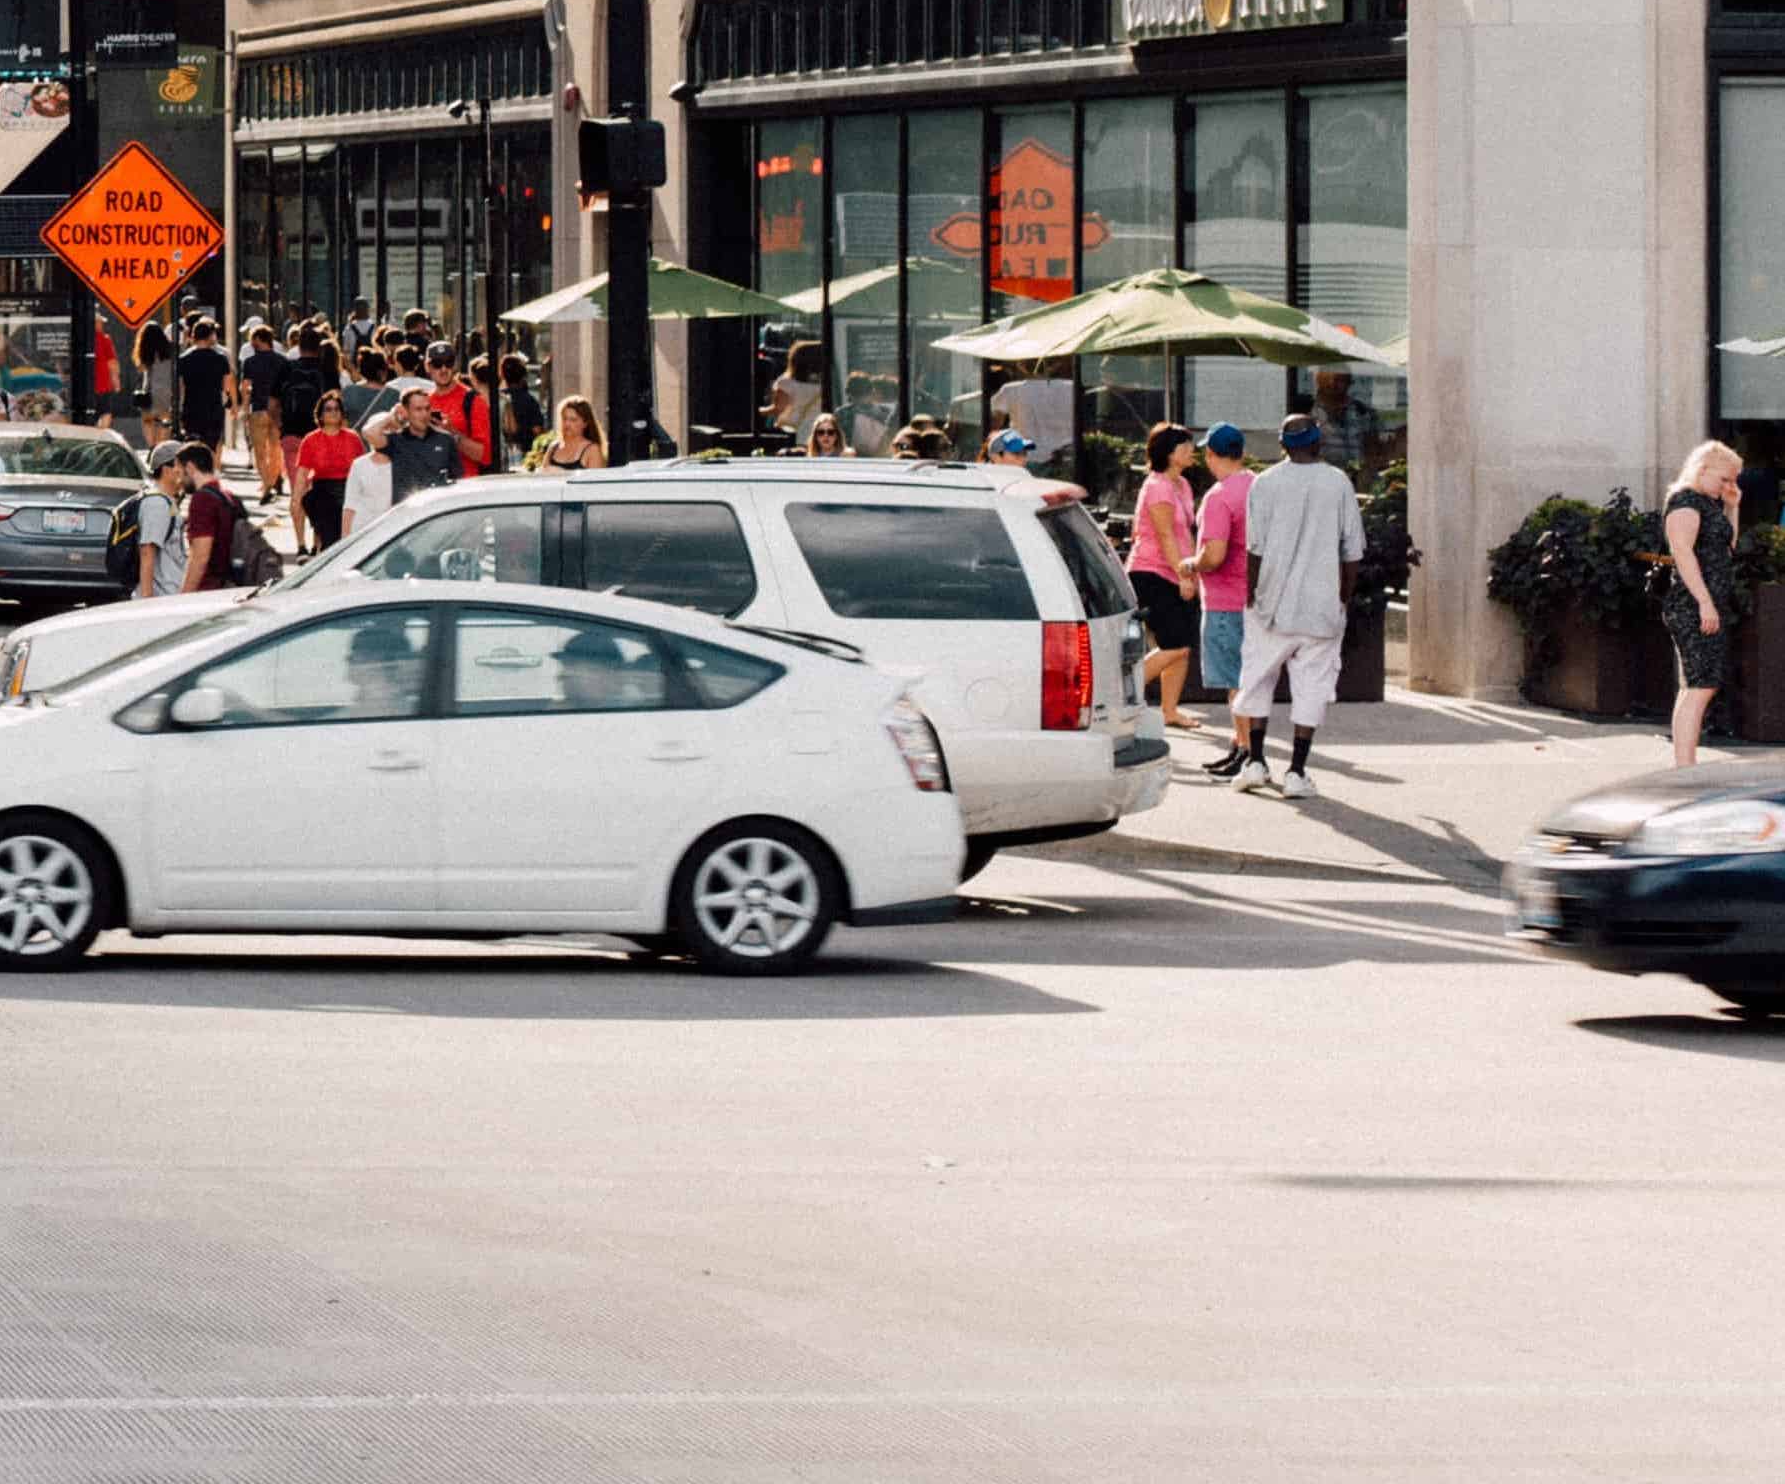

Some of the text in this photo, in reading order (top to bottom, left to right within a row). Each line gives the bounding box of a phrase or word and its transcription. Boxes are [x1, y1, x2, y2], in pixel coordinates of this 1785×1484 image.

[105, 191, 163, 212] ROAD
[58, 224, 209, 245] CONSTRUCTION
[99, 258, 169, 279] AHEAD
